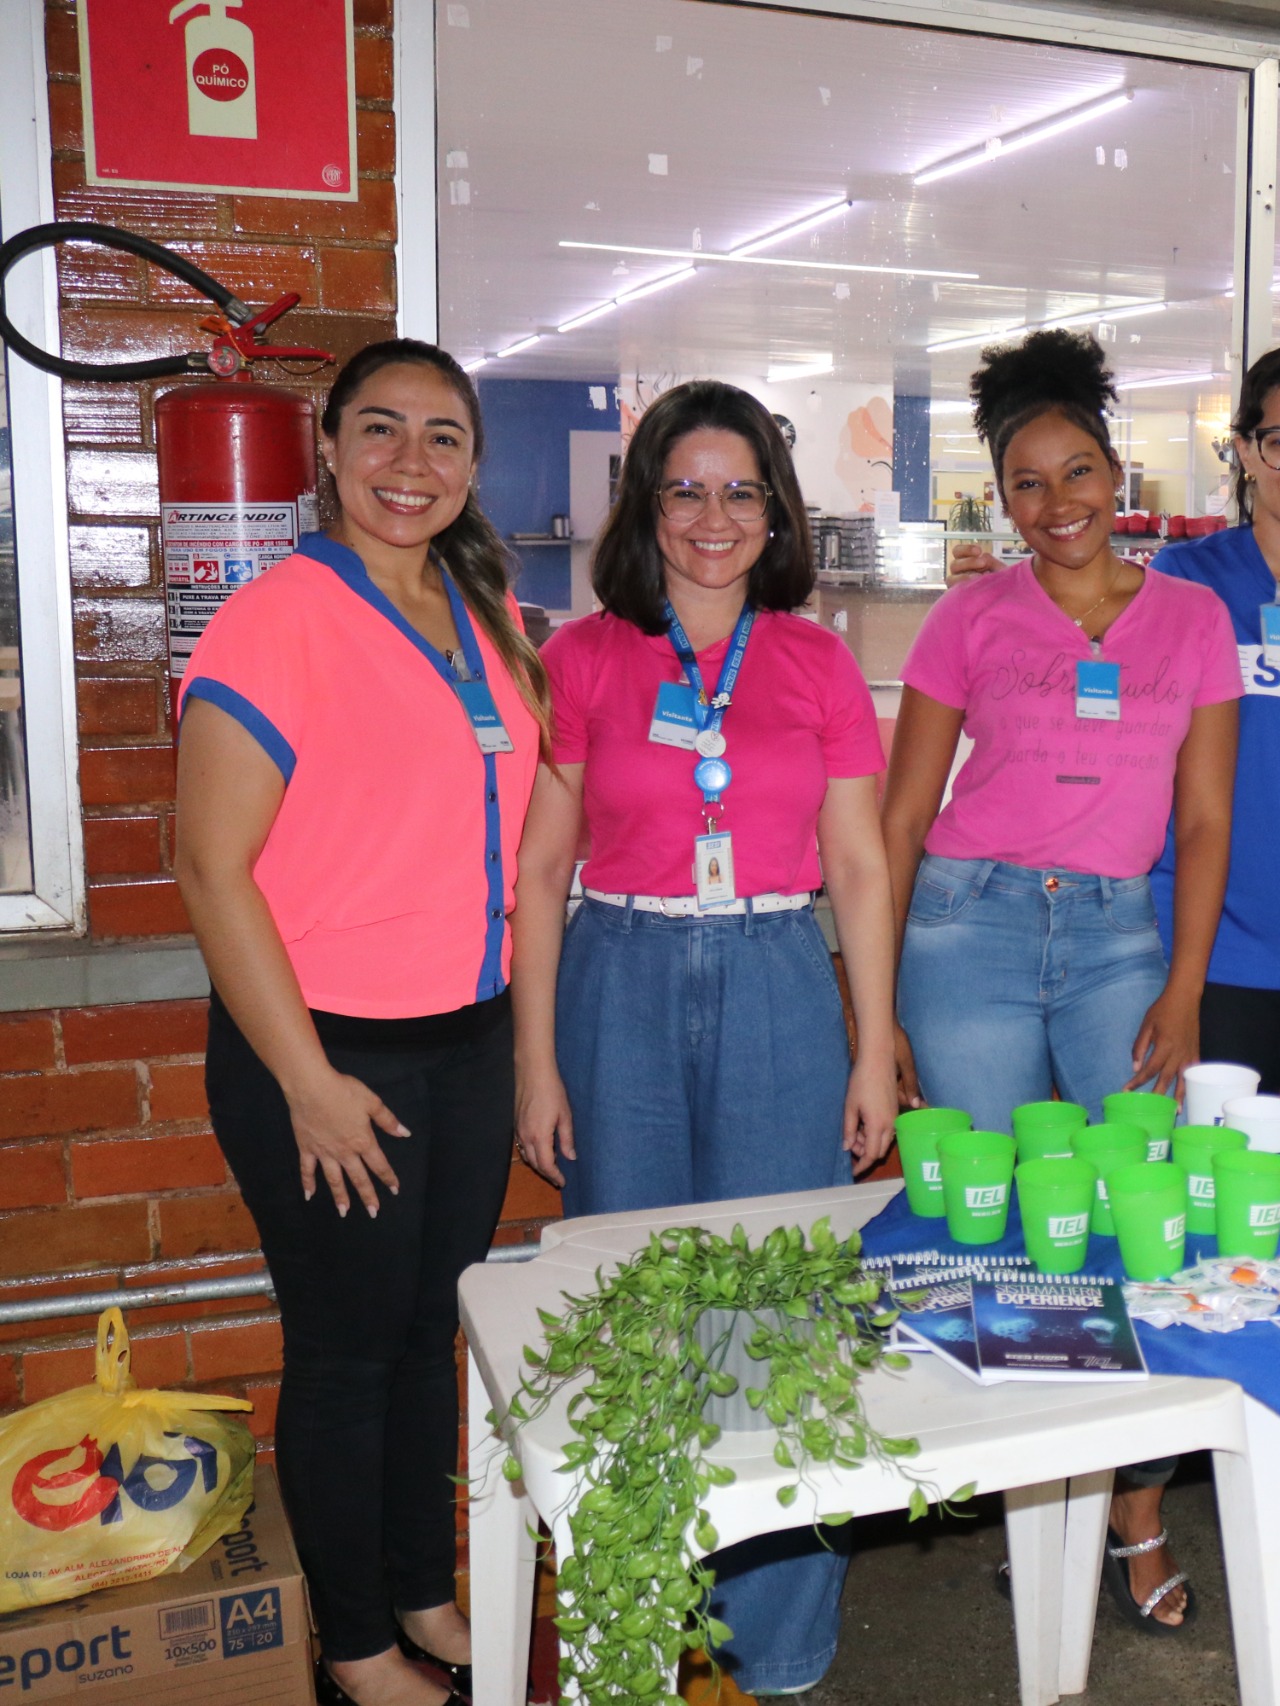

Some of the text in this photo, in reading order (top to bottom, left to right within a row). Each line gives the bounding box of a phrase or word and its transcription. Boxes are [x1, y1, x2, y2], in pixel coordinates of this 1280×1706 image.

[212, 63, 230, 75] PÓ
[195, 74, 247, 89] QUÍMICO
[1083, 687, 1113, 696] Visitante
[662, 710, 693, 722] Visitante
[1147, 1144, 1166, 1159] EL
[972, 1189, 1002, 1205] IEL
[1055, 1218, 1084, 1235] IEL
[995, 1284, 1102, 1298] SISTEMA FIERN
[996, 1293, 1105, 1308] EXPERIENCE
[5, 1571, 30, 1579] LOJA
[89, 1552, 157, 1569] ALEXANDRINO
[226, 1592, 277, 1630] A4
[164, 1638, 217, 1660] 10x500
[228, 1631, 273, 1652] 75 20
[78, 1662, 134, 1684] suzano
